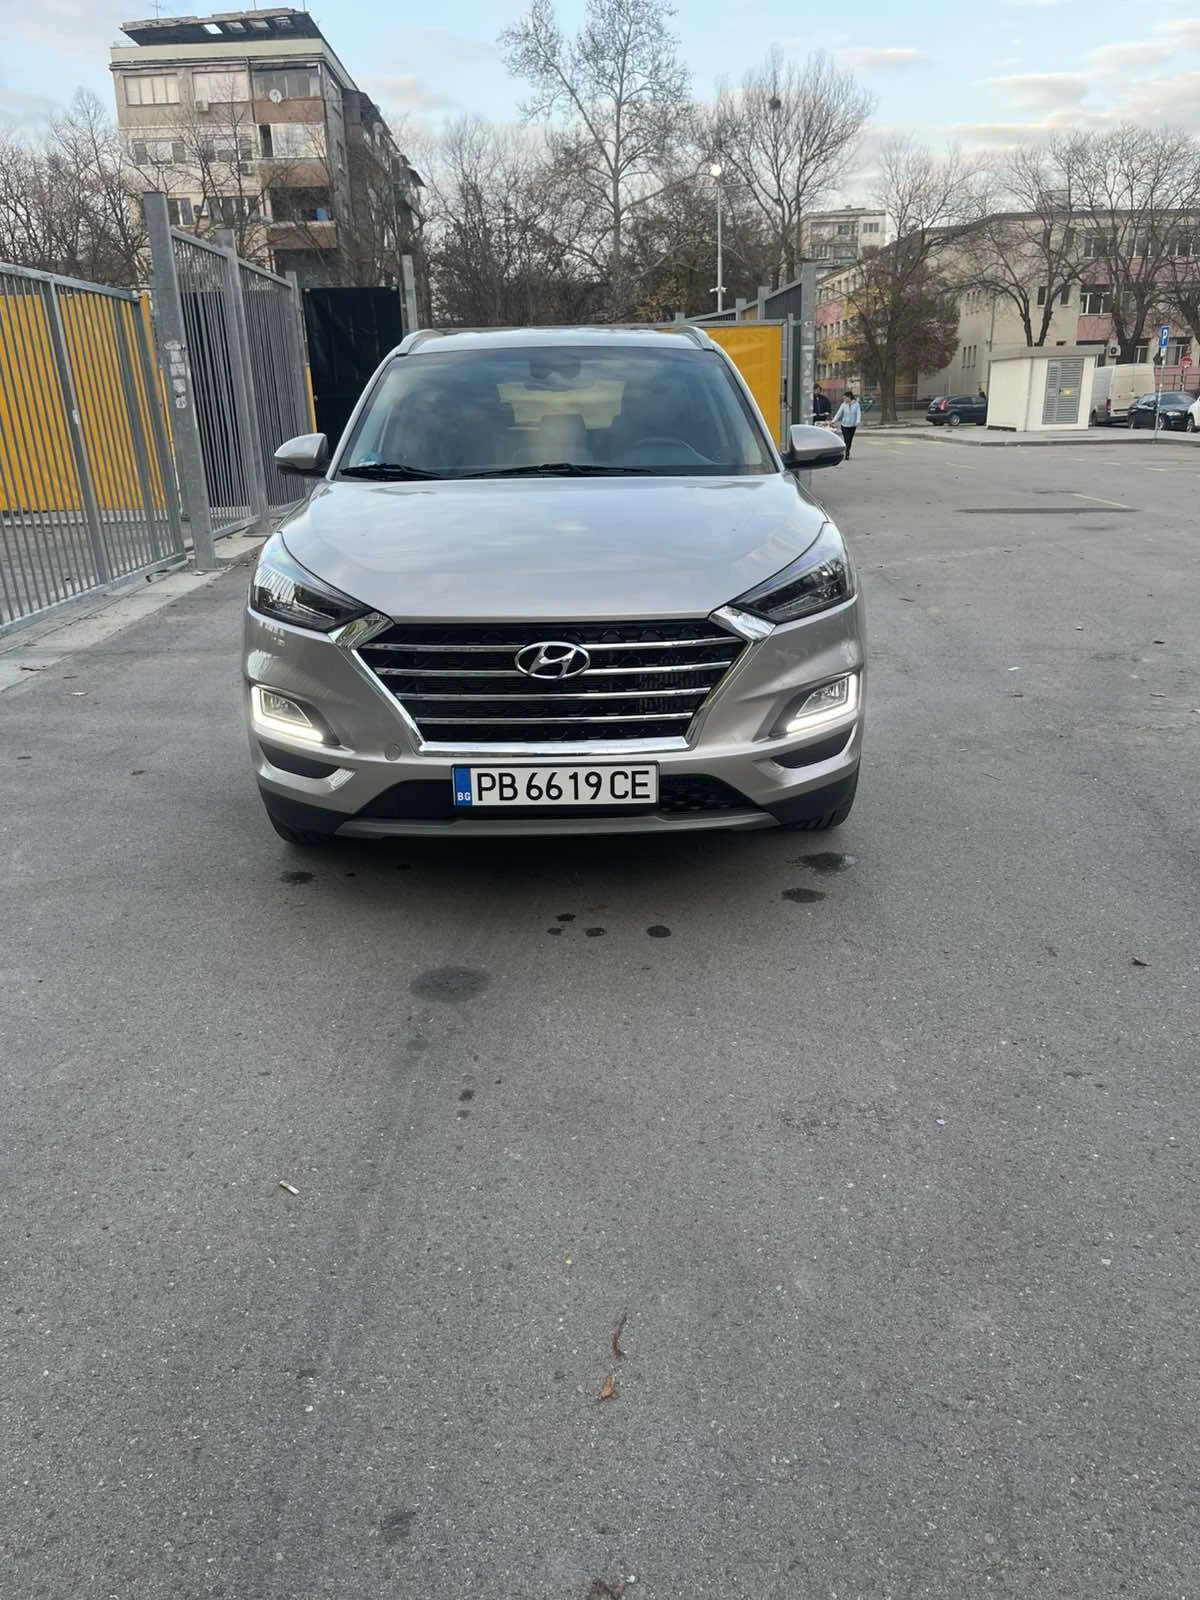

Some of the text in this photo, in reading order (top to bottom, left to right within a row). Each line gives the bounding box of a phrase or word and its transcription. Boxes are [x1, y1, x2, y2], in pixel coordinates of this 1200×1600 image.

[1161, 328, 1168, 345] P
[476, 770, 650, 801] PB 6619 CE
[456, 791, 471, 801] BG
